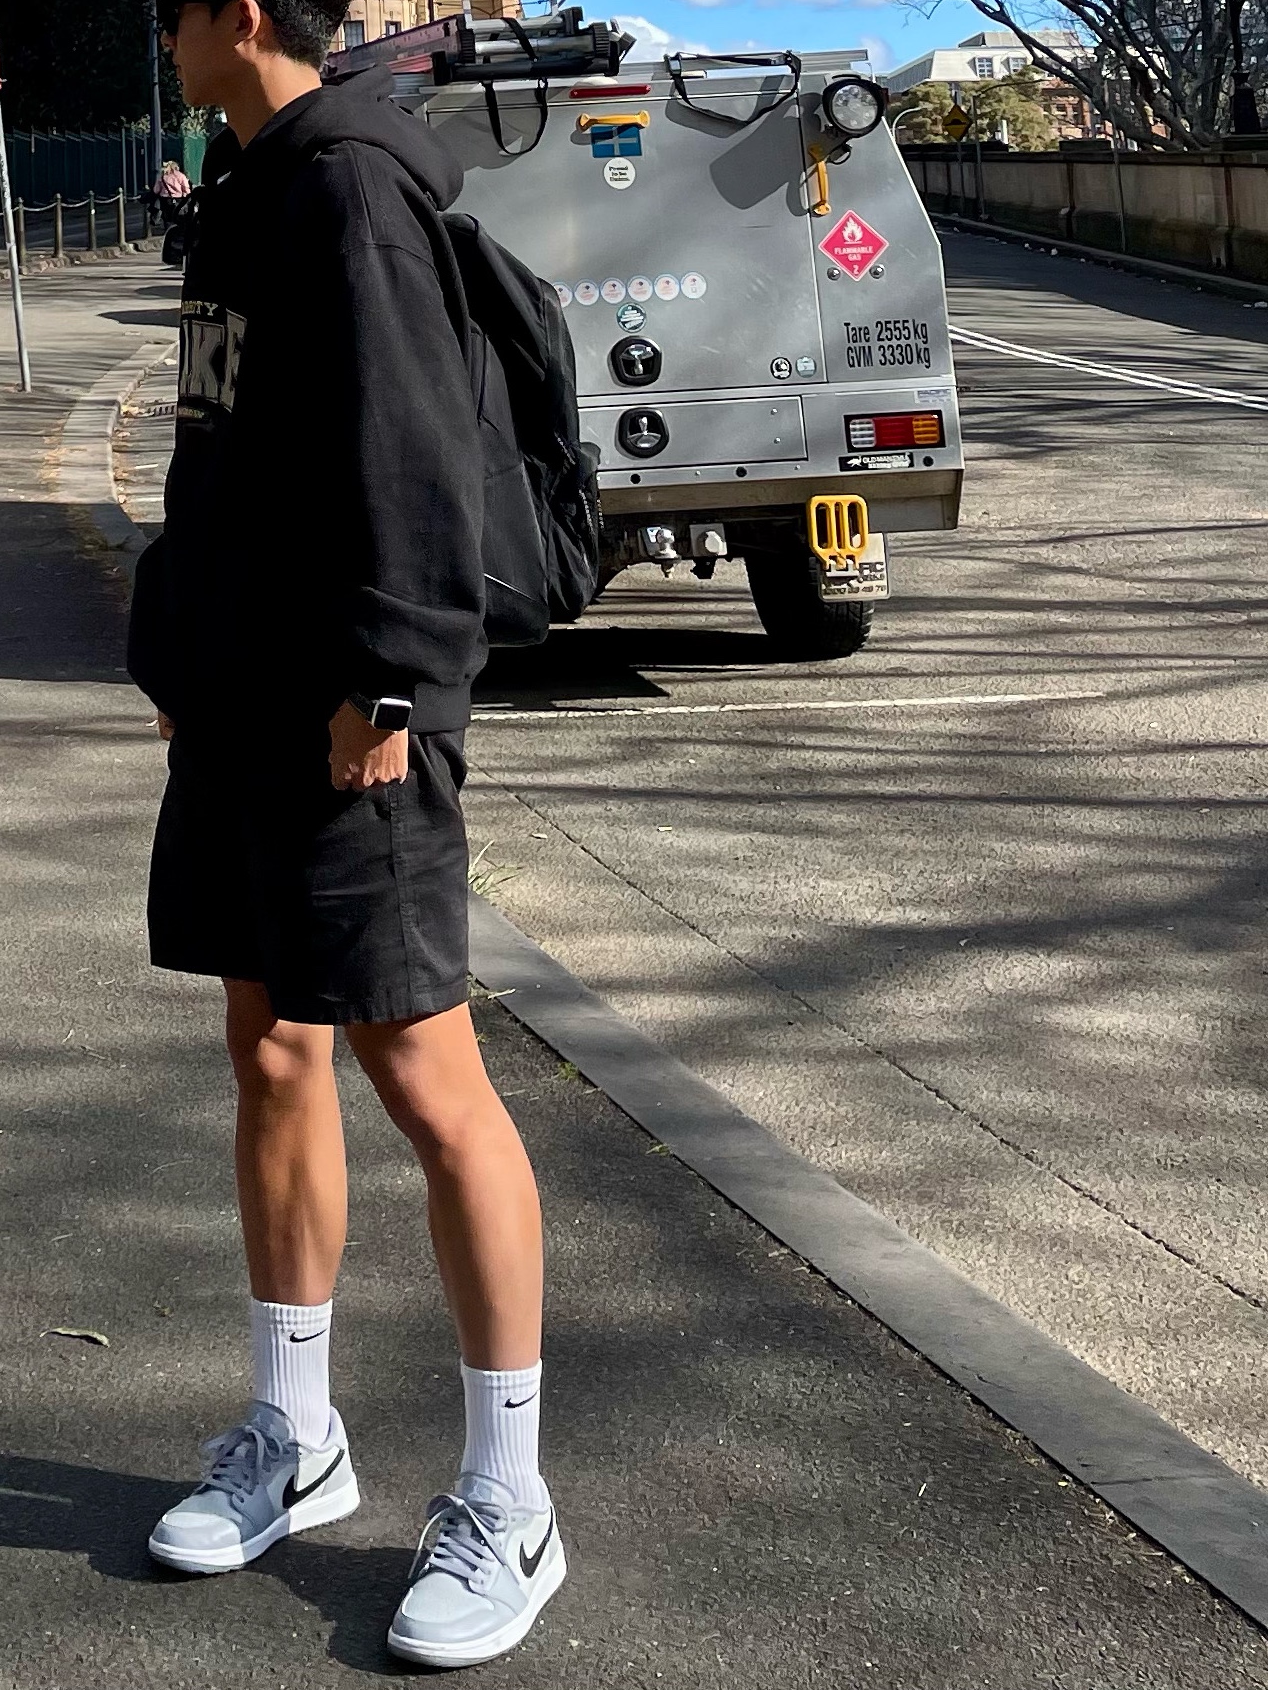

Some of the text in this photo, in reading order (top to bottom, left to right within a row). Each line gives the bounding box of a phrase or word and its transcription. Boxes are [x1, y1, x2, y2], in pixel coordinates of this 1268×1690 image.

[834, 246, 874, 255] FLAMMABLE
[847, 254, 862, 262] GAS
[852, 264, 860, 275] 2
[843, 318, 929, 345] Tare 2555 kg
[846, 342, 931, 370] GVM 3330 kg
